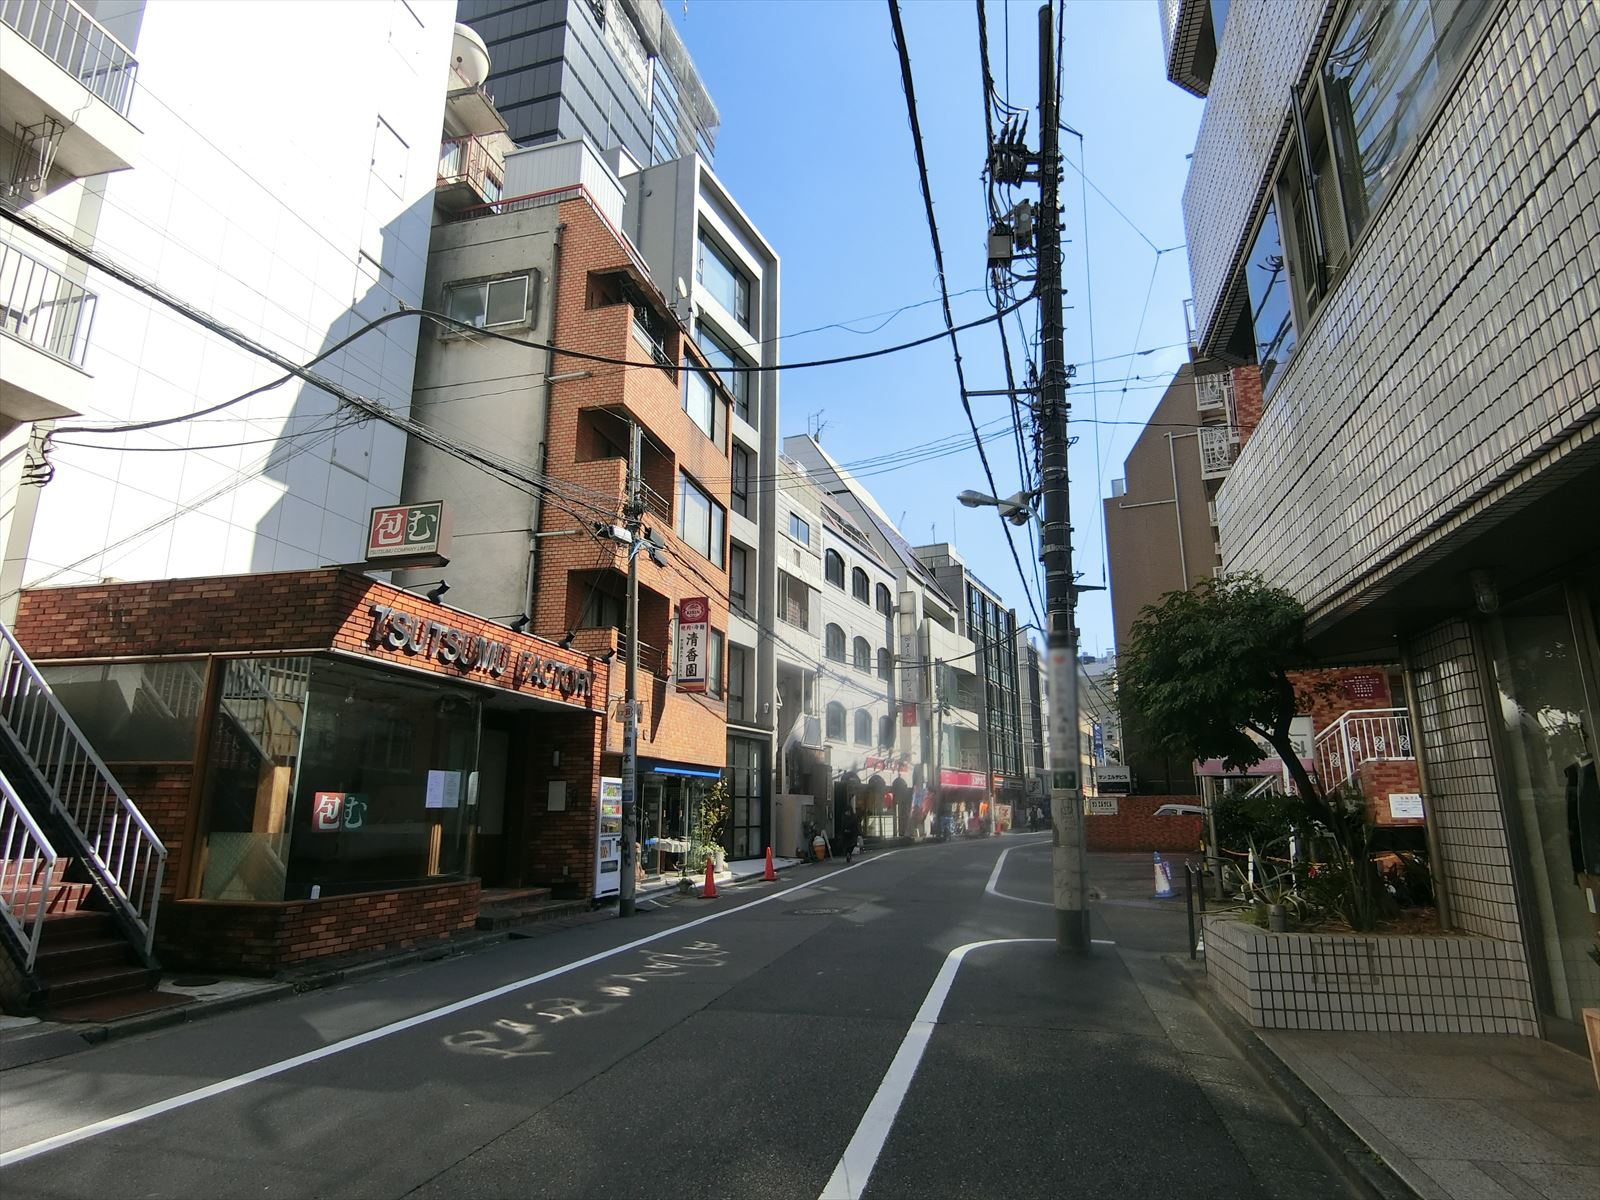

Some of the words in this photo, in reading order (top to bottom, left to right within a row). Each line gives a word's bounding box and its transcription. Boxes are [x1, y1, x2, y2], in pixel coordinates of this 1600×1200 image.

[374, 510, 437, 545] 包む
[393, 546, 417, 554] COMPANY
[417, 544, 436, 552] LIMITED
[368, 604, 511, 675] TSUTSUMU
[518, 651, 594, 697] FACTORY
[315, 794, 368, 831] 包む
